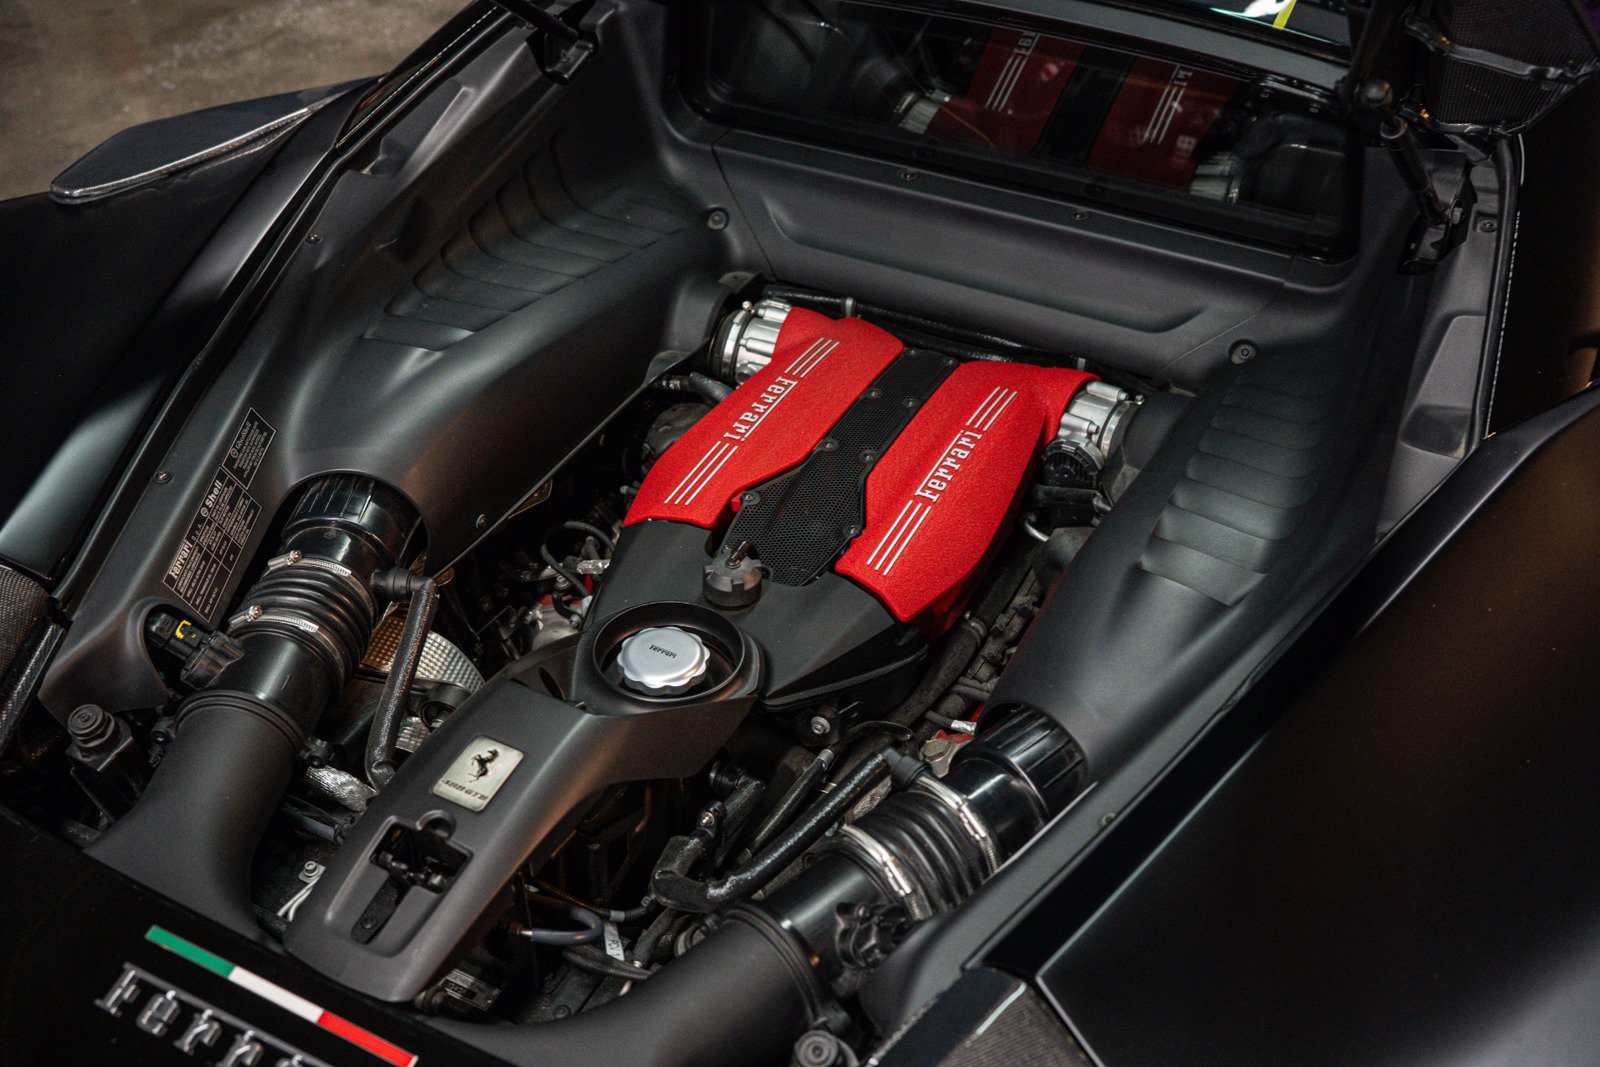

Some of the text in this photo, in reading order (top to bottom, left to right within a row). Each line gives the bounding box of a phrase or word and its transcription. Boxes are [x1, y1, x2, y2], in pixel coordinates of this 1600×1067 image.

[723, 376, 798, 441] Ferrari
[915, 430, 982, 502] Ferrari
[168, 539, 193, 580] Ferrari
[204, 479, 223, 509] Shell
[649, 645, 678, 658] Ferrari
